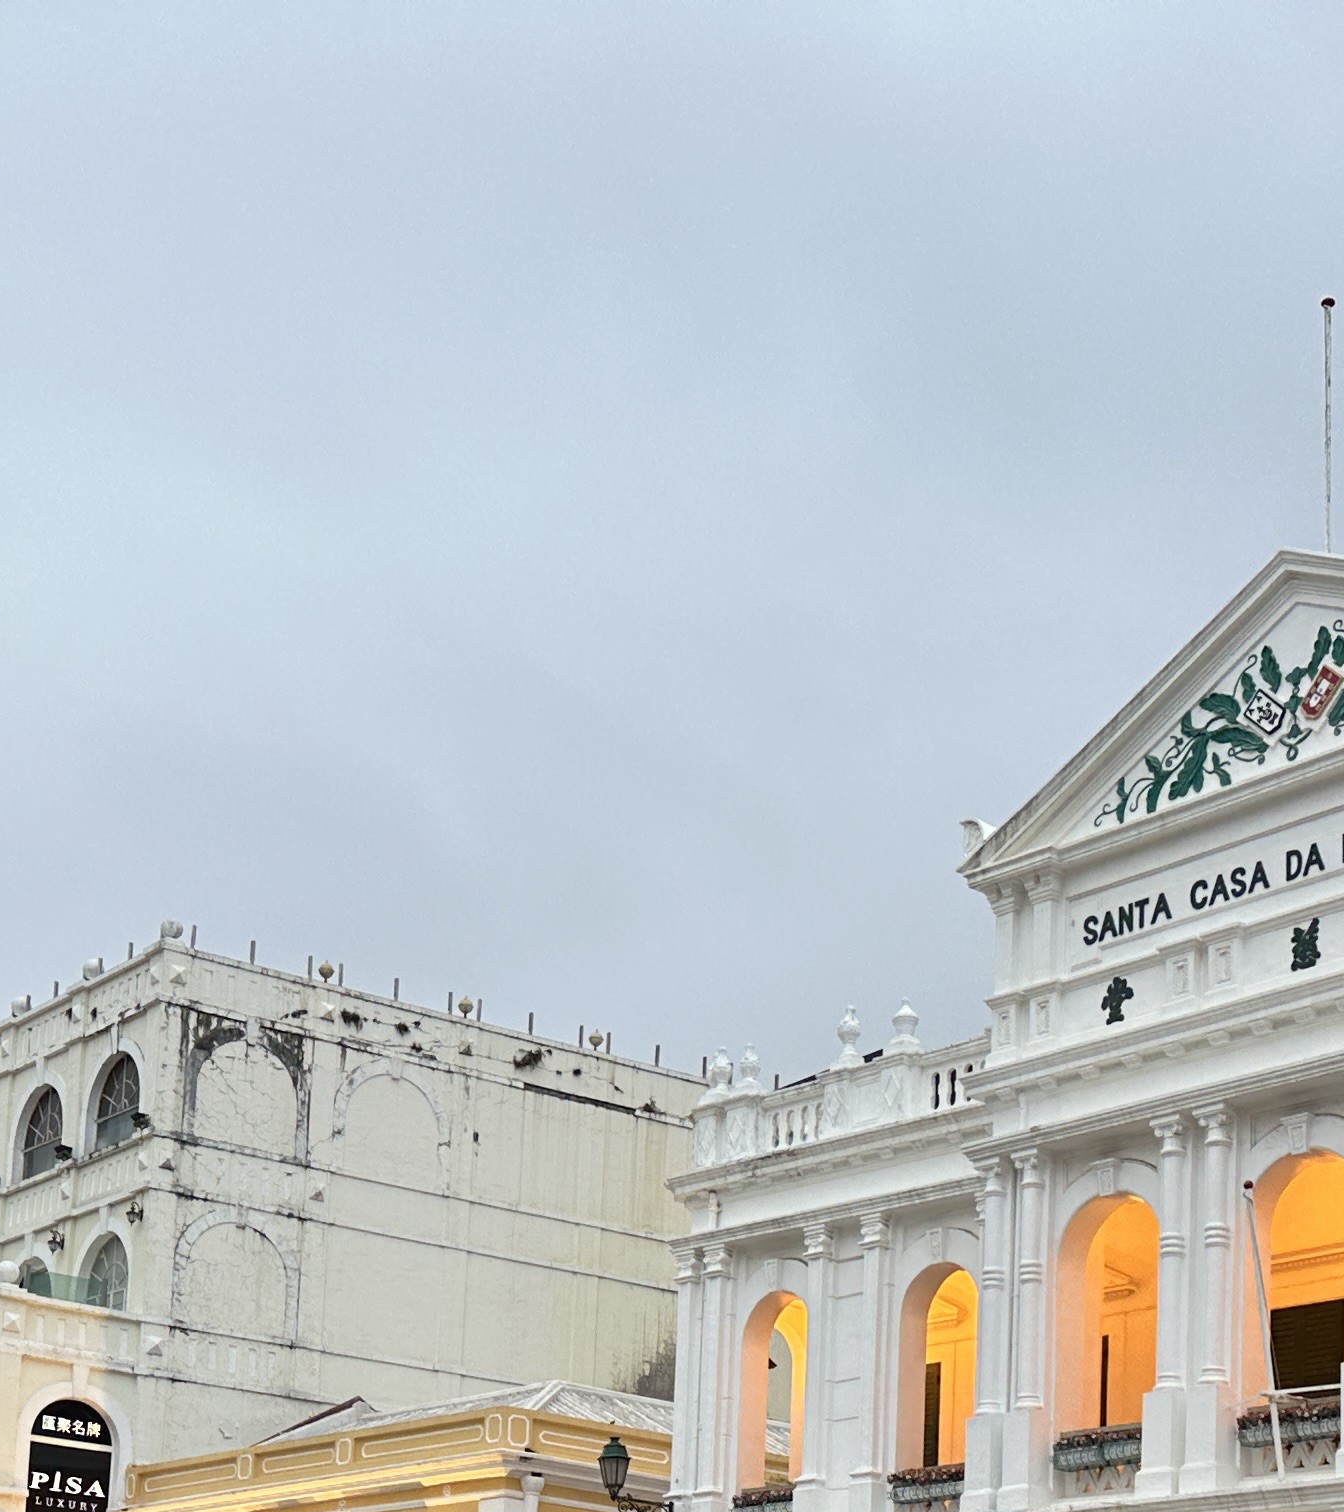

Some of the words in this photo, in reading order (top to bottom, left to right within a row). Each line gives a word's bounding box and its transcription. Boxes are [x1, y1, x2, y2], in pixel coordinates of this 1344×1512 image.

[1082, 892, 1173, 946] SANTA
[1189, 860, 1271, 911] CASA
[1285, 842, 1325, 882] DA
[28, 1470, 106, 1499] PISA
[34, 1496, 98, 1512] LUXURY
